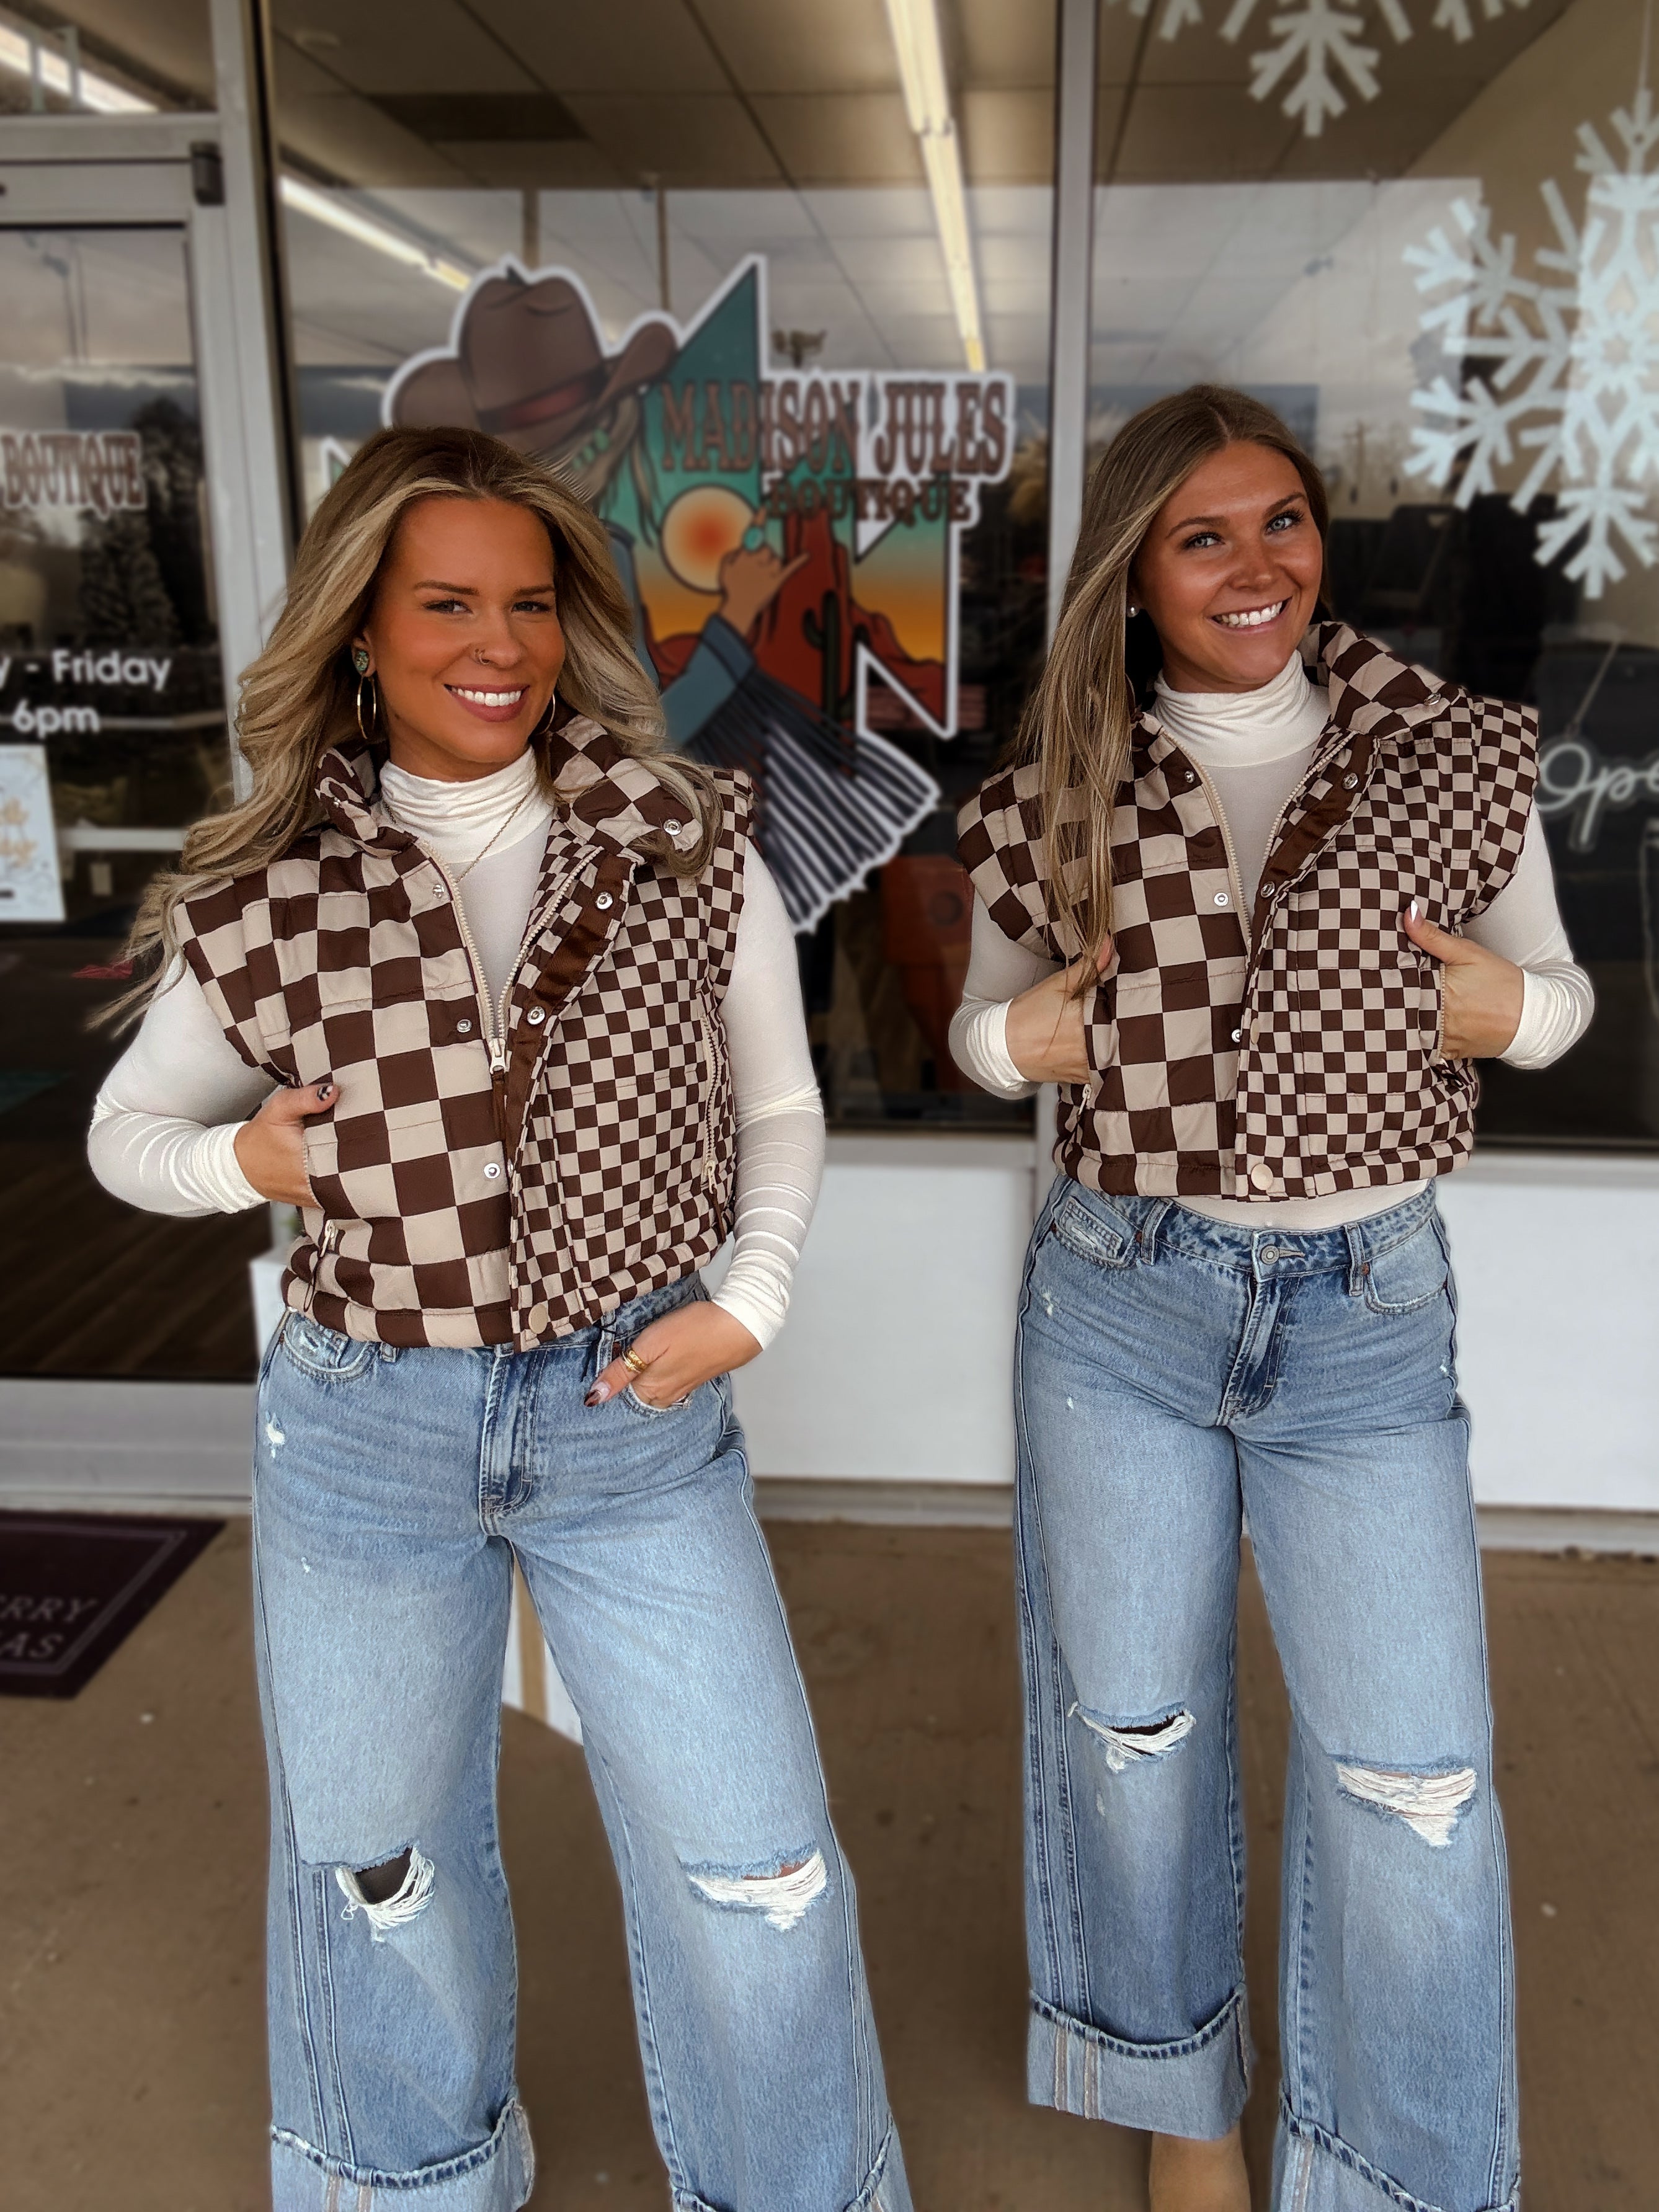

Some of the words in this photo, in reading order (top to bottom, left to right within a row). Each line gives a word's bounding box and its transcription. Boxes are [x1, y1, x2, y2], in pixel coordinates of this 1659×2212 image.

[660, 378, 860, 473] MADISON
[874, 380, 1007, 475] JULES
[0, 432, 143, 515] BOUTIQUE
[766, 477, 972, 526] BOUTIQUE
[51, 649, 171, 691] Friday
[12, 699, 100, 739] 6pm
[0, 1595, 99, 1623] RRY
